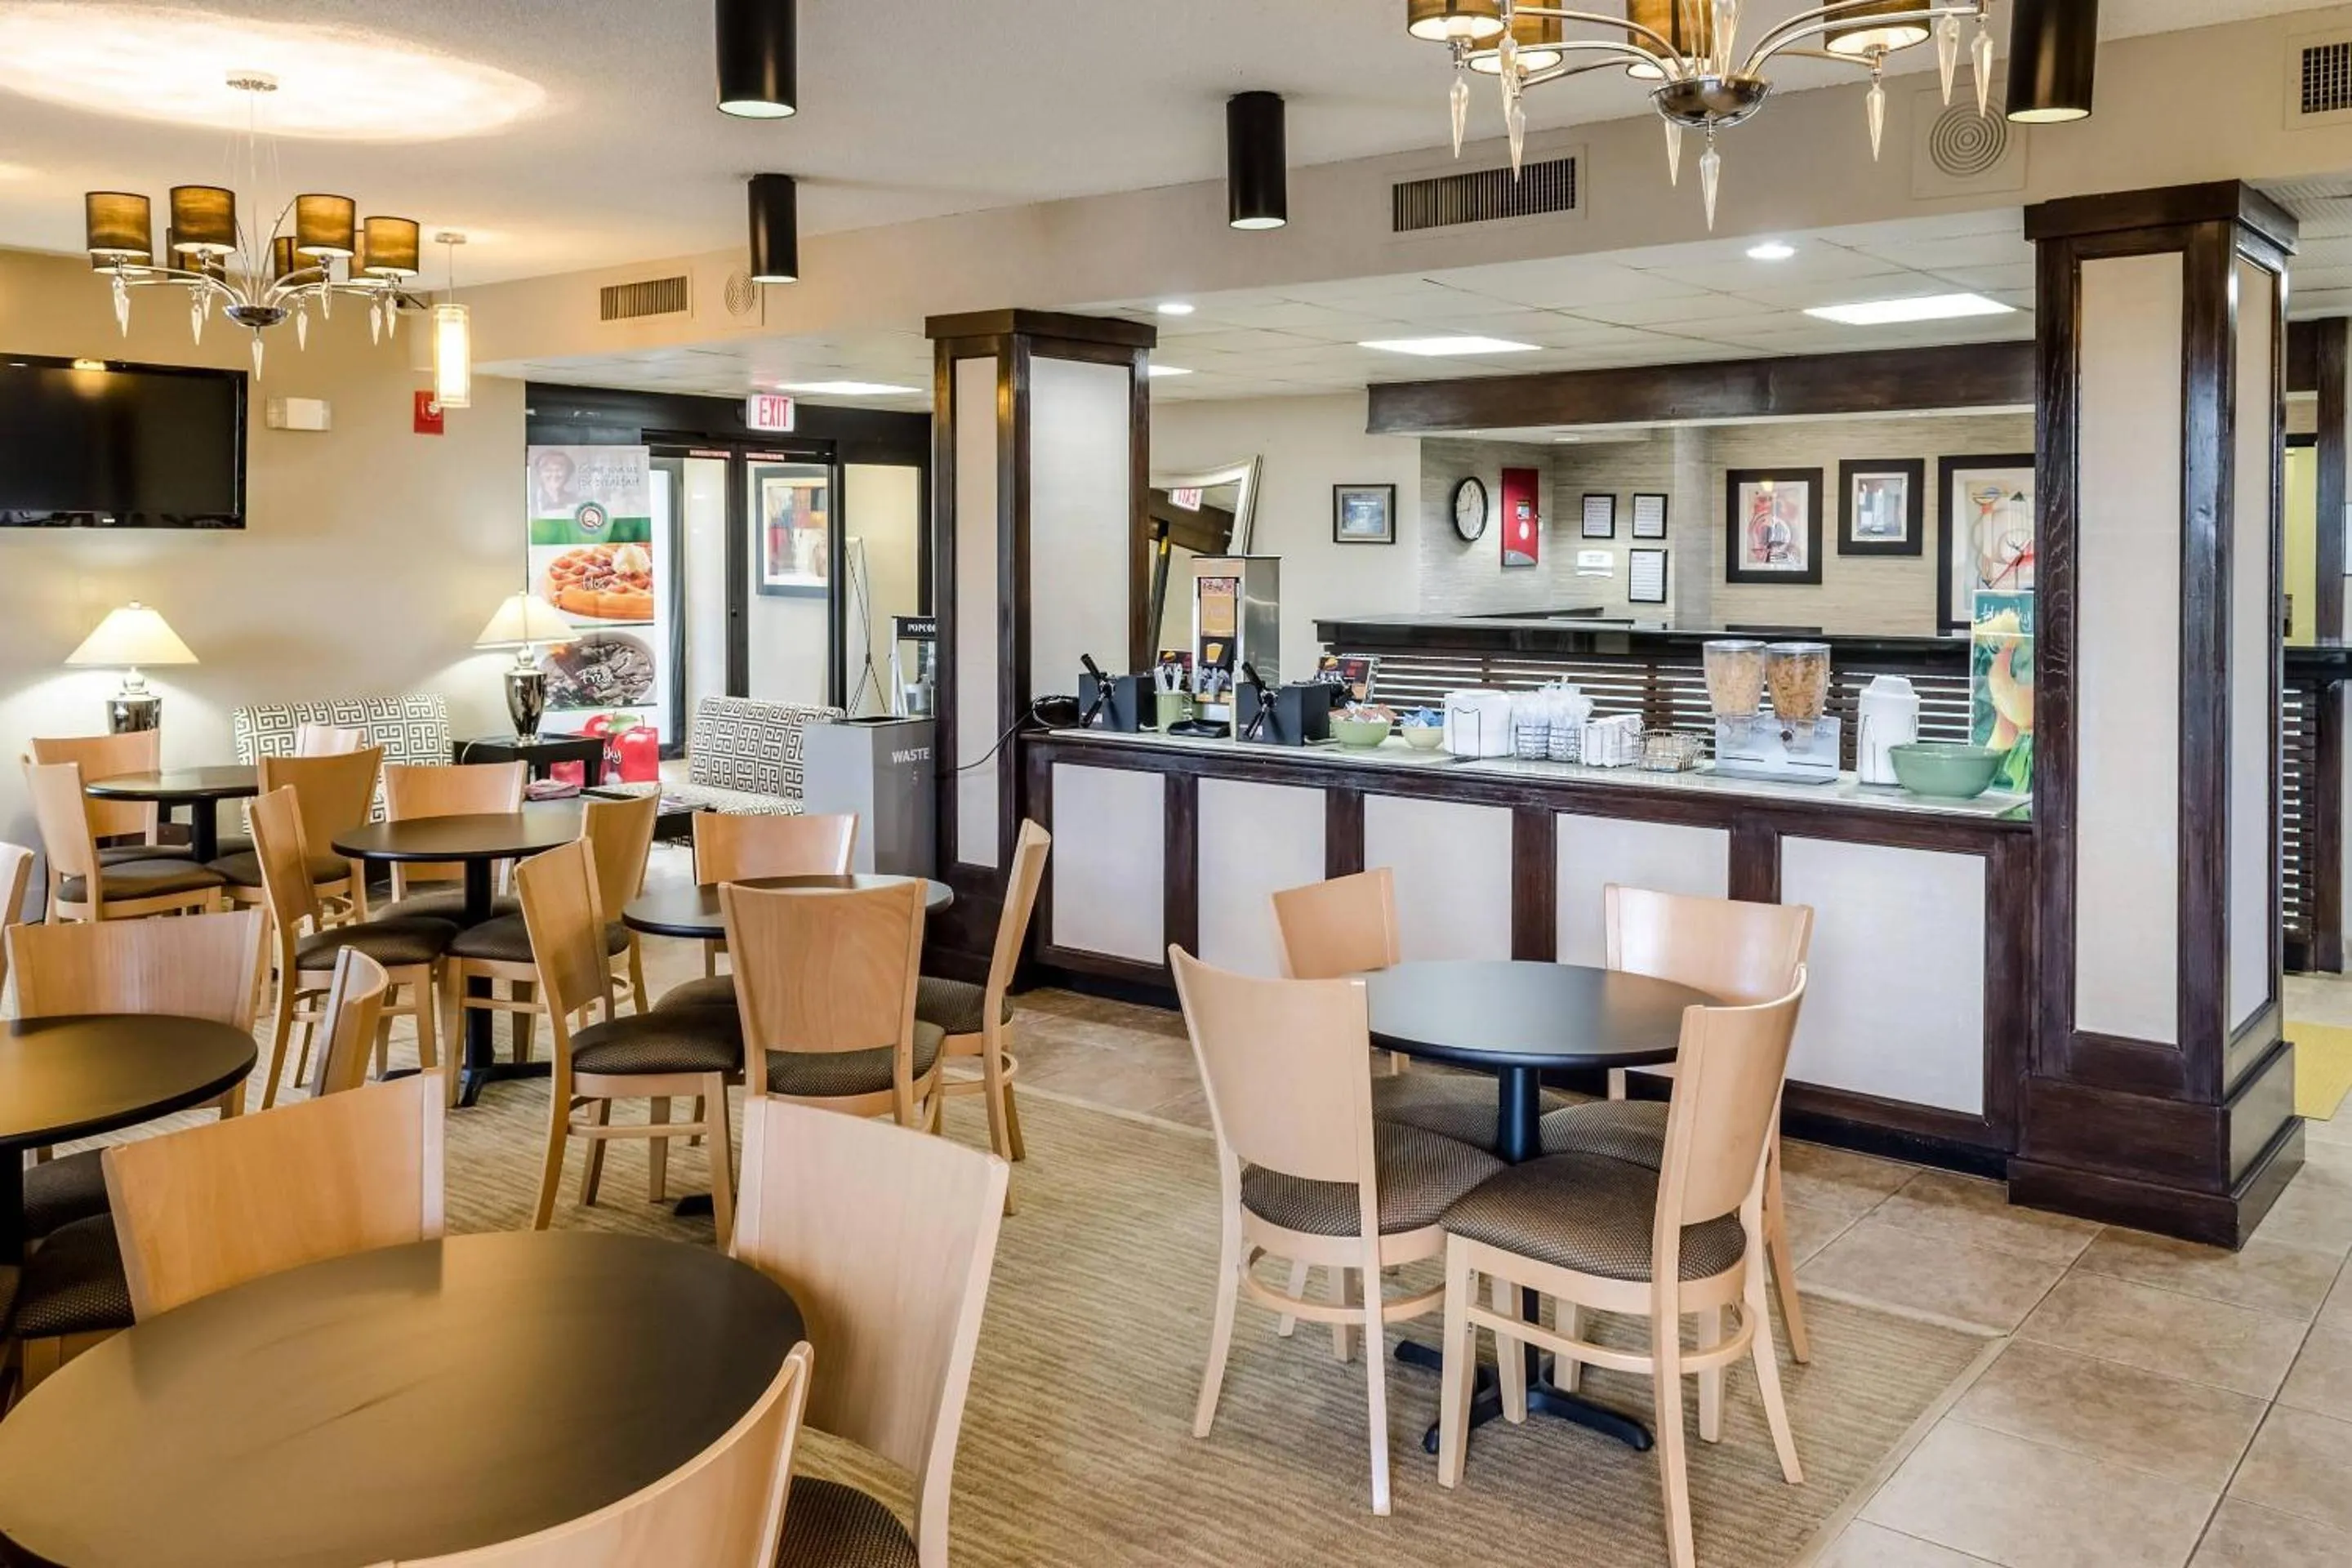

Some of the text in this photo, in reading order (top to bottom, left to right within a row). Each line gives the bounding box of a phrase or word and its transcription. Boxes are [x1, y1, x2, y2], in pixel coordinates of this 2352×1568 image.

[759, 397, 788, 427] EXIT
[907, 623, 936, 633] POPCO
[892, 747, 930, 764] WASTE
